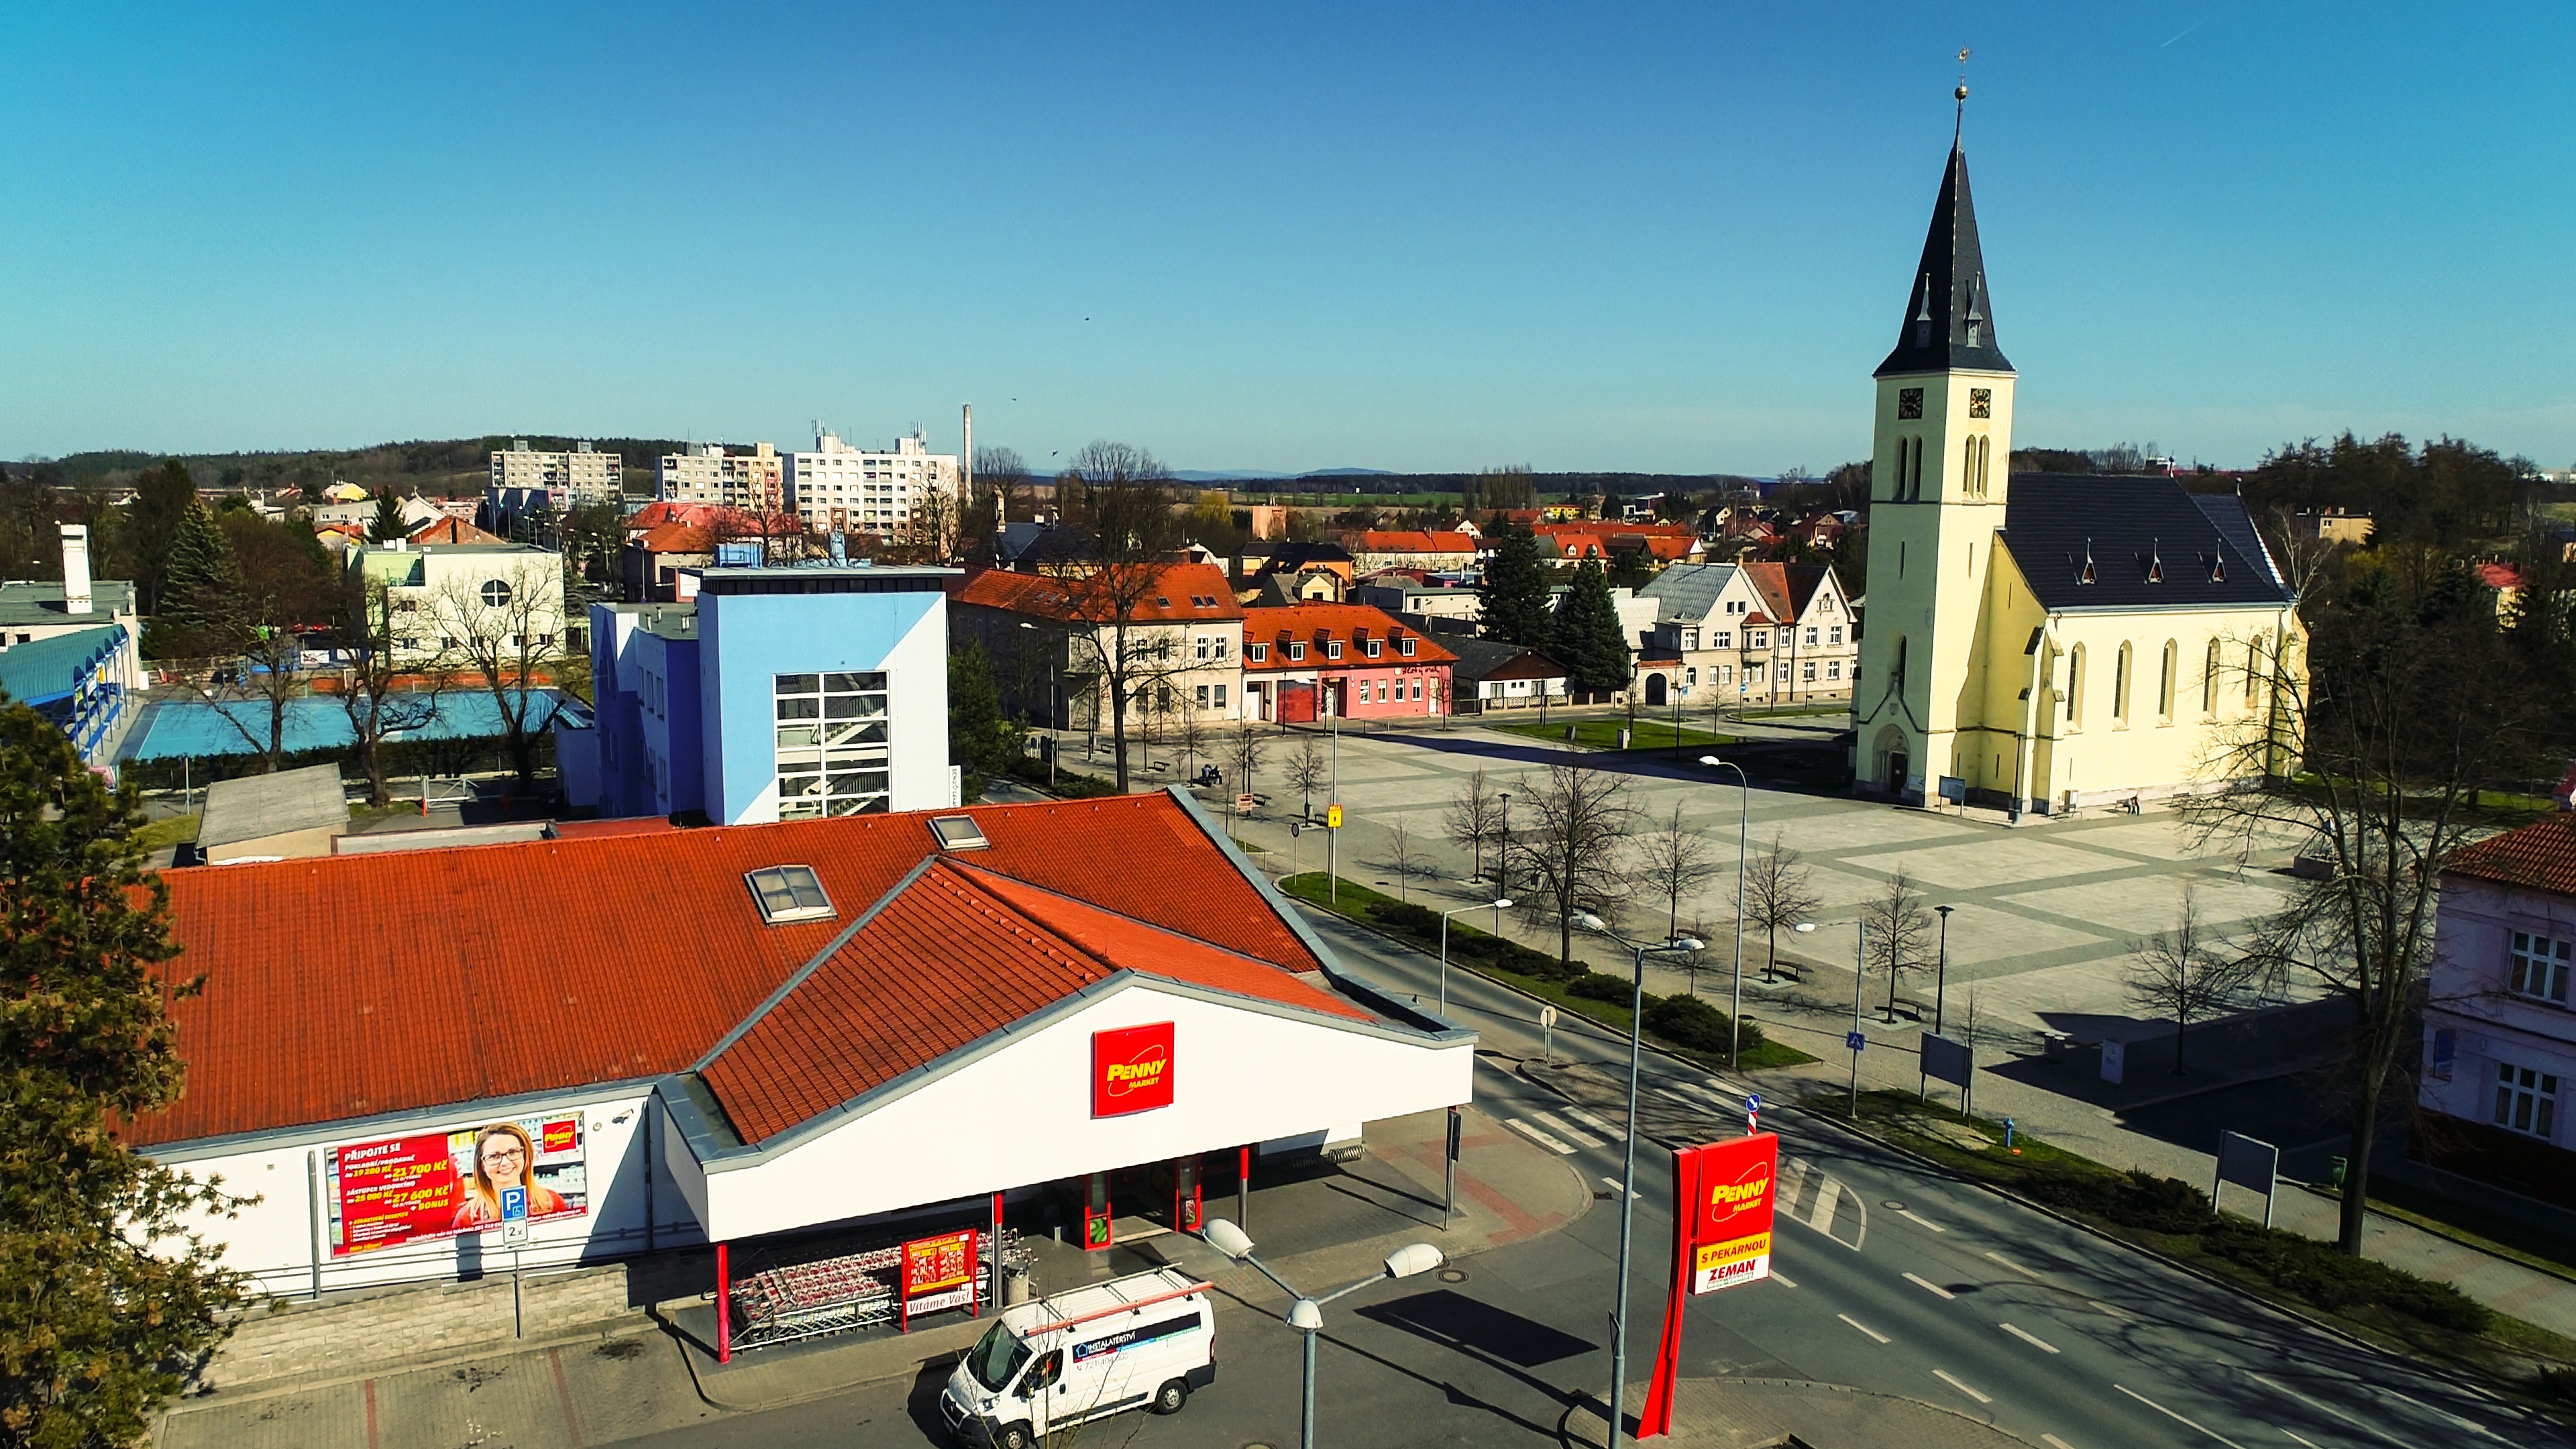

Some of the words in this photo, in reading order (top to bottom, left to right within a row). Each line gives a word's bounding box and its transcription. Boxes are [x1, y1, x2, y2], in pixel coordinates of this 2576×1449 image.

[1107, 1059, 1167, 1081] PENNY
[1128, 1077, 1159, 1089] MARKET
[344, 1144, 388, 1162] PŘIPOJTE
[390, 1142, 401, 1152] SE
[392, 1168, 407, 1177] 21
[409, 1163, 431, 1175] 700
[433, 1159, 448, 1171] Kč
[392, 1193, 408, 1203] 27
[411, 1189, 433, 1201] 600
[435, 1185, 449, 1196] Kč
[1711, 1177, 1769, 1205] PENNY
[419, 1199, 449, 1210] BONUS
[506, 1192, 521, 1211] P
[1733, 1198, 1762, 1213] MARKET
[1701, 1252, 1708, 1263] S
[1711, 1238, 1766, 1261] PEKÁRNOU
[1709, 1259, 1756, 1281] ZEMAN
[909, 1298, 945, 1313] Vítáme
[949, 1291, 969, 1305] Vás!
